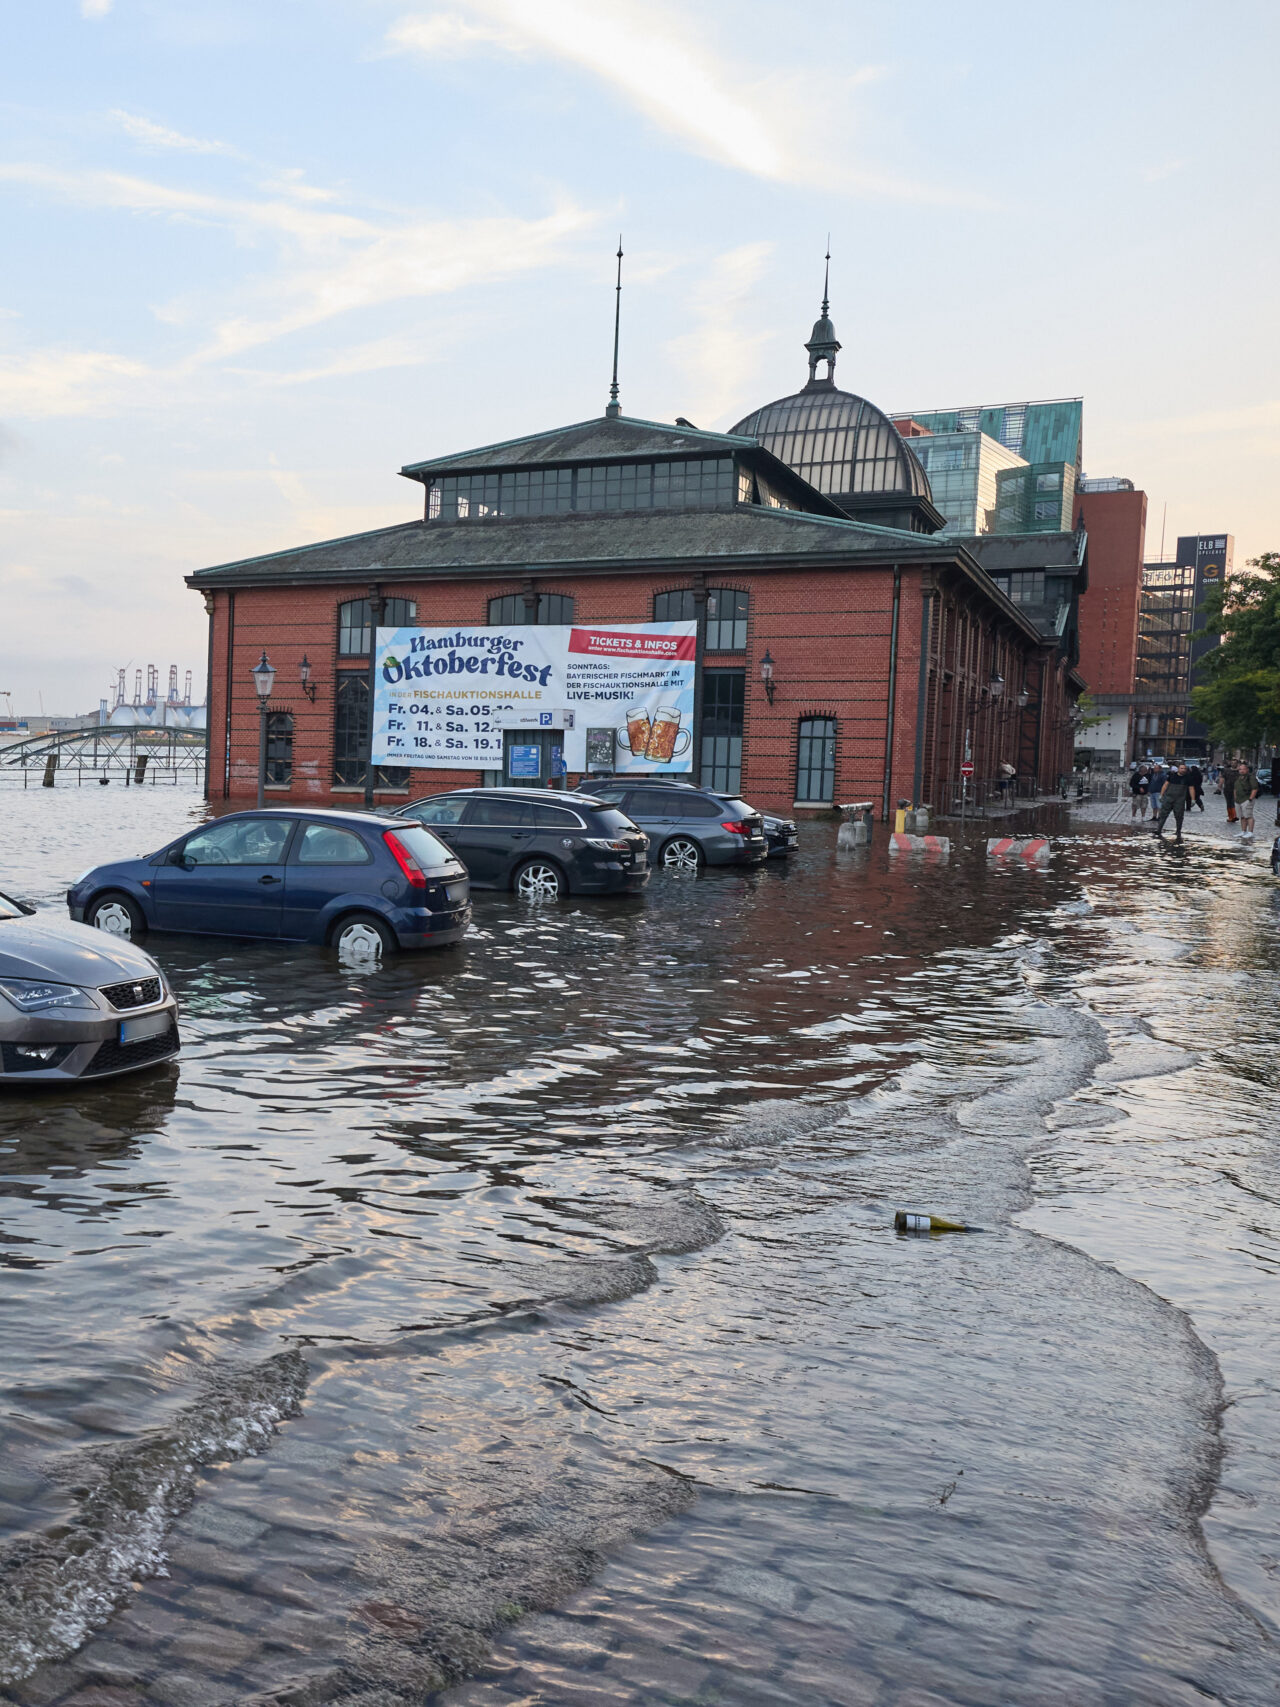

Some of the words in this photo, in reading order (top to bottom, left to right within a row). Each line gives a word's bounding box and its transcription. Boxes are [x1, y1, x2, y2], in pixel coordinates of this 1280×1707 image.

[1199, 541, 1214, 550] ELB
[409, 632, 524, 655] Hamburger
[589, 636, 632, 648] TICKETS
[634, 640, 642, 648] &
[644, 640, 678, 651] INFOS
[382, 649, 553, 687] Oktoberfest
[620, 671, 670, 679] FISCHMARKT
[583, 681, 669, 689] FISCHAUKTIONSHALLE
[413, 690, 543, 700] FISCHAUKTIONSHALLE
[566, 691, 634, 700] LIVE-MUSIK!
[388, 703, 406, 714] Fr.
[409, 704, 434, 715] 04.
[435, 706, 442, 714] &
[445, 705, 469, 716] Sa.
[387, 719, 406, 730] Fr.
[416, 720, 433, 731] 11.
[435, 723, 442, 731] &
[445, 721, 469, 732] Sa.
[387, 735, 405, 746] Fr.
[413, 736, 432, 748] 18.
[434, 739, 441, 747] &
[445, 737, 468, 749] Sa.
[473, 738, 501, 749] 19.1
